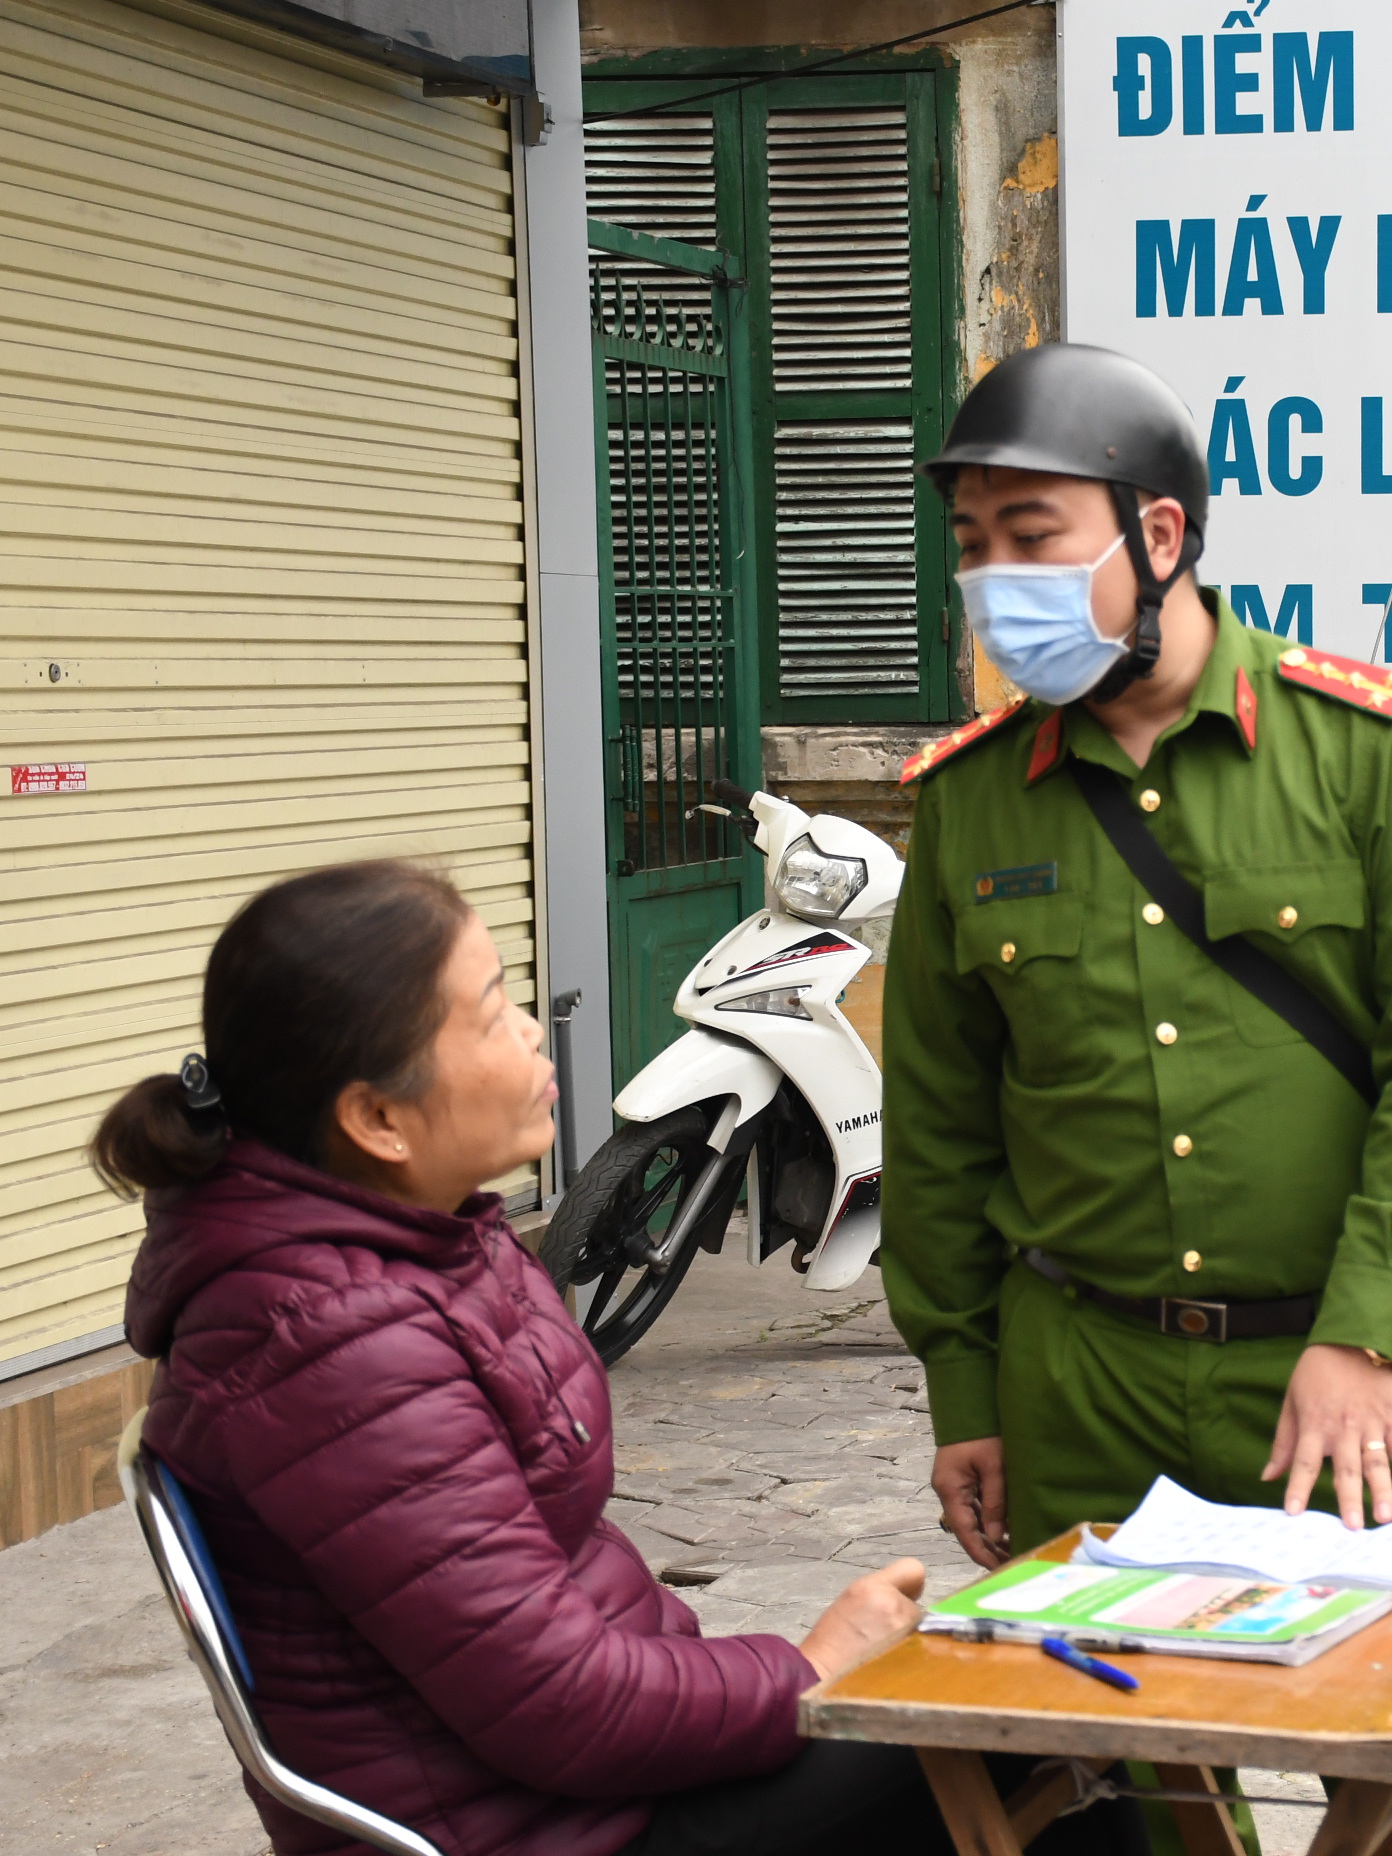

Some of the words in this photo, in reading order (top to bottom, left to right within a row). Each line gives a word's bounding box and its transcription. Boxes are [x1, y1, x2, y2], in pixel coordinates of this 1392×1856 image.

[1113, 0, 1355, 137] ĐIỂM
[1136, 194, 1343, 318] MÁY
[1188, 376, 1323, 496] ÁC
[1214, 583, 1314, 648] M
